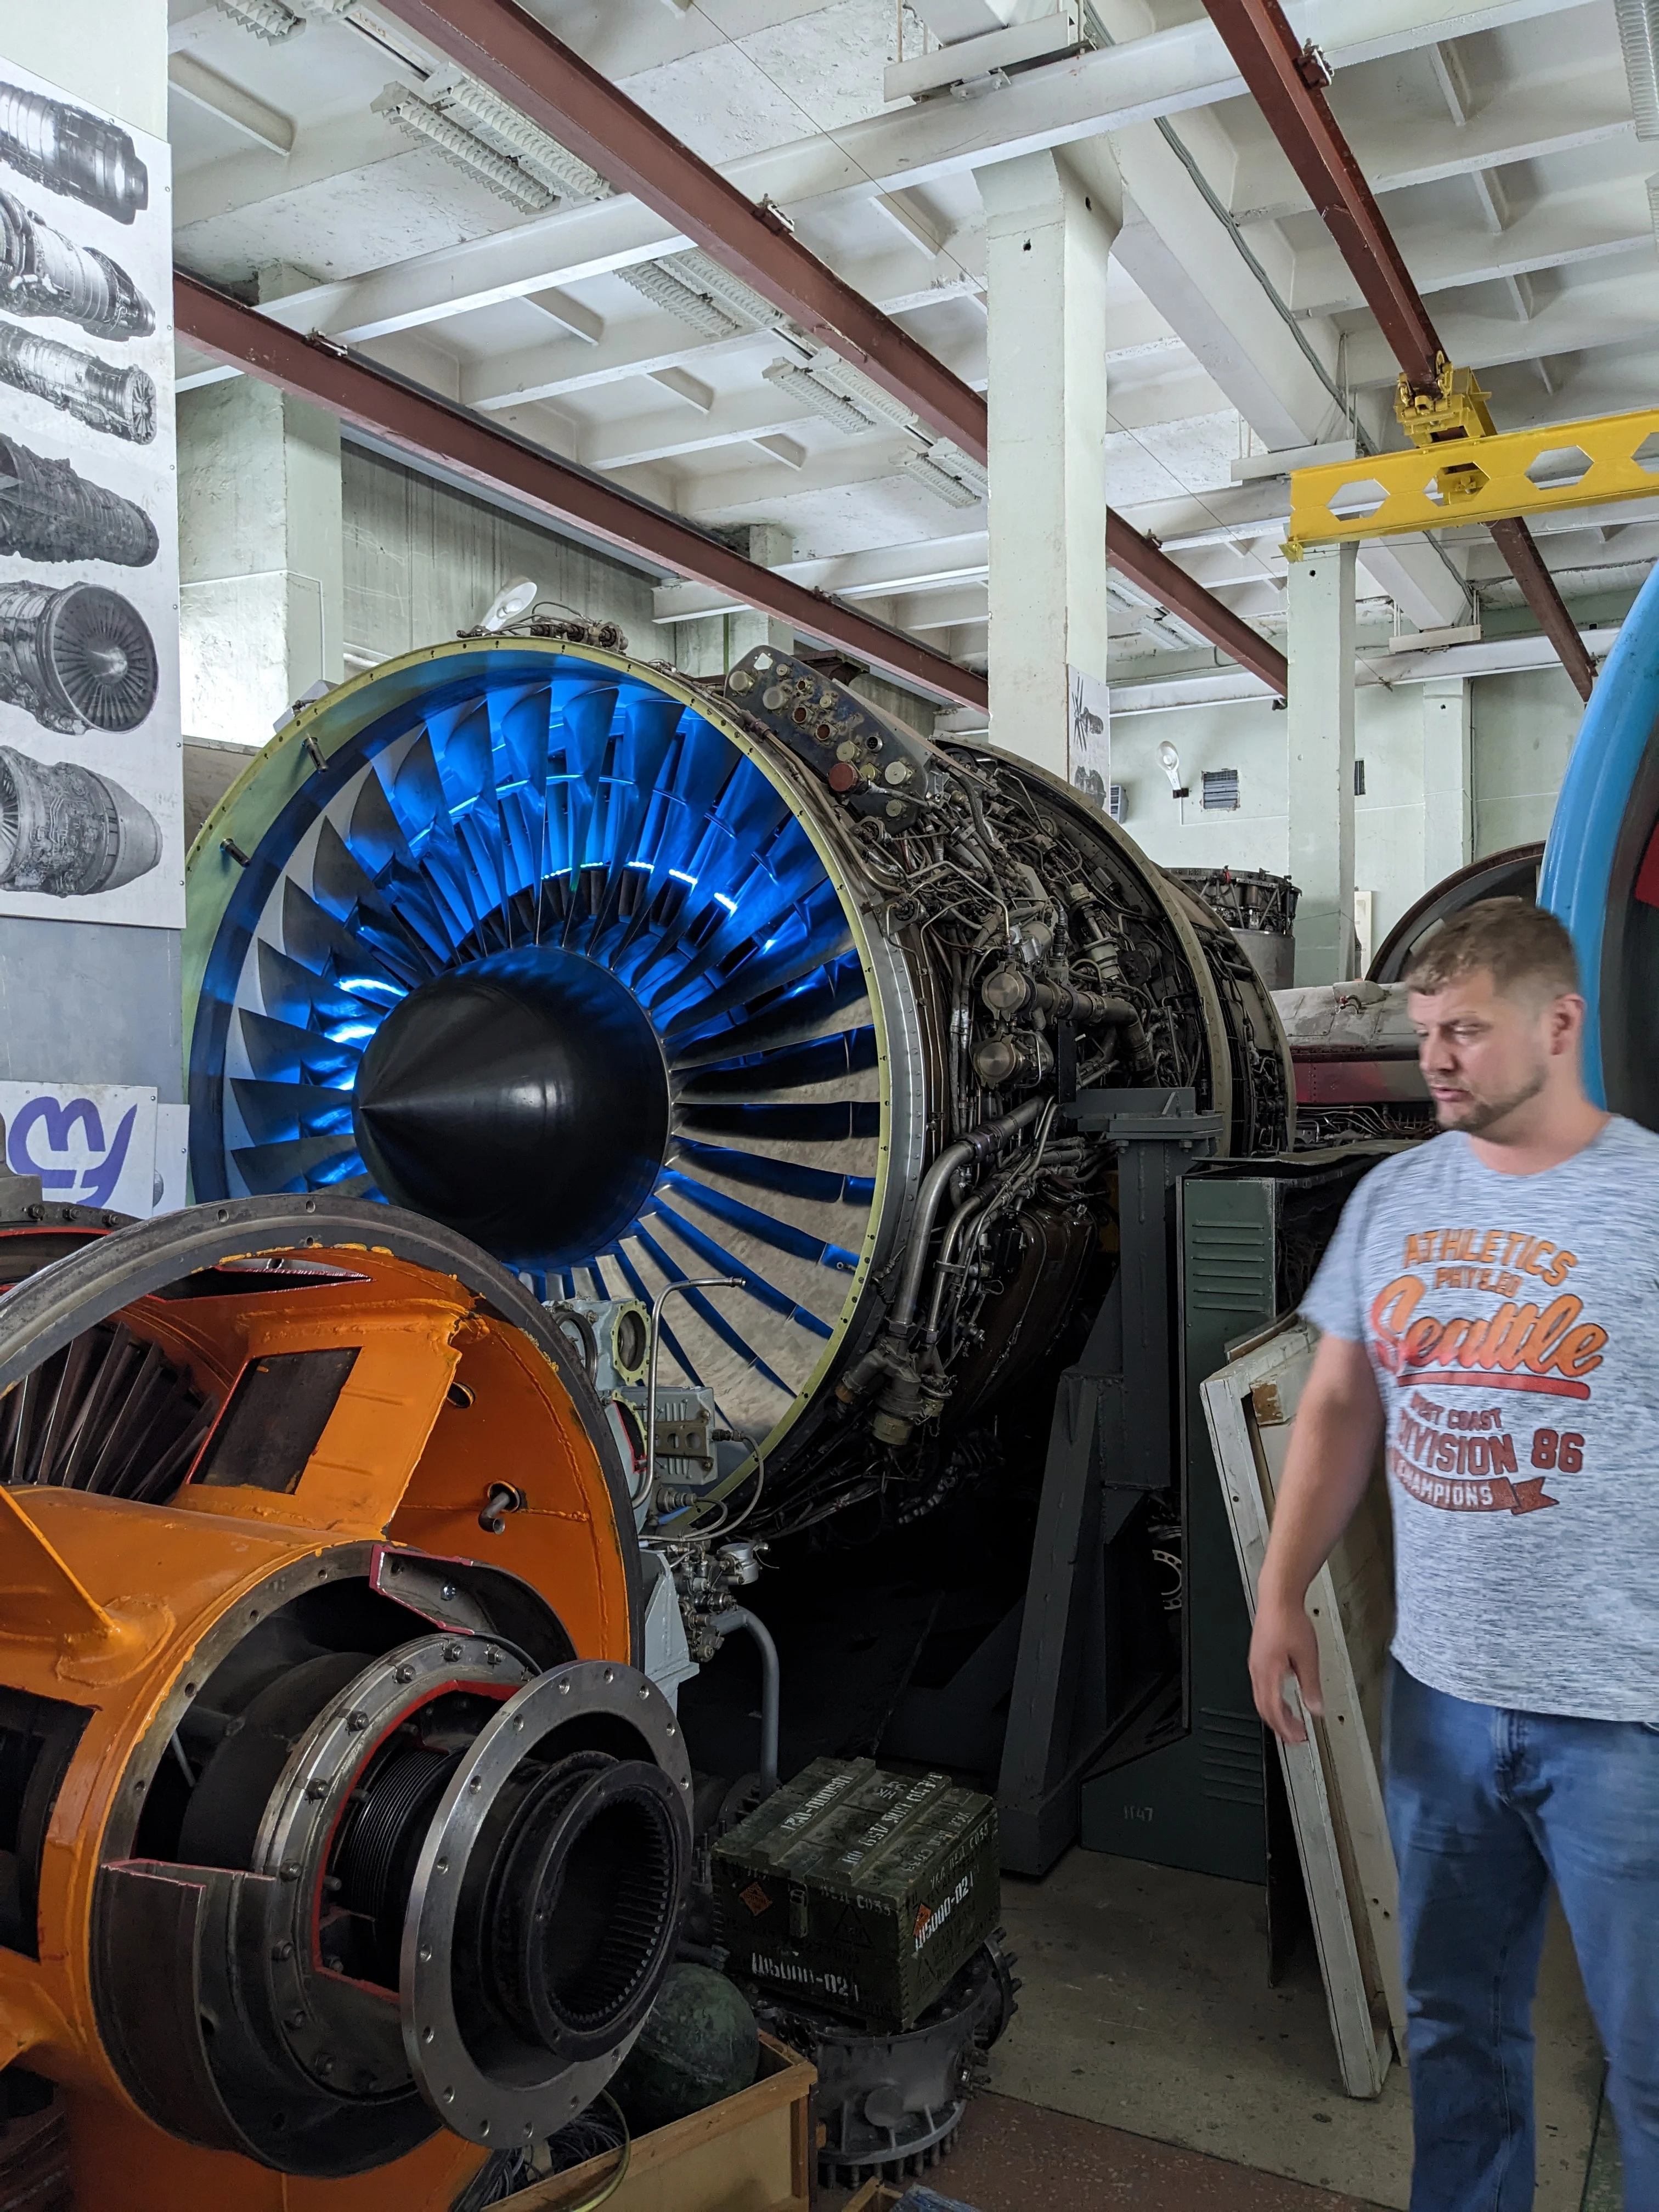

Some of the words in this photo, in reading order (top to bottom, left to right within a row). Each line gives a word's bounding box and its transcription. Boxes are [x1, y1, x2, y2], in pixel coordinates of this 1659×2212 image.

[1402, 1228, 1578, 1286] ATHLETICS
[1370, 1274, 1609, 1378] Seattle
[1448, 1408, 1502, 1431] COAST
[1531, 1427, 1585, 1474] 86
